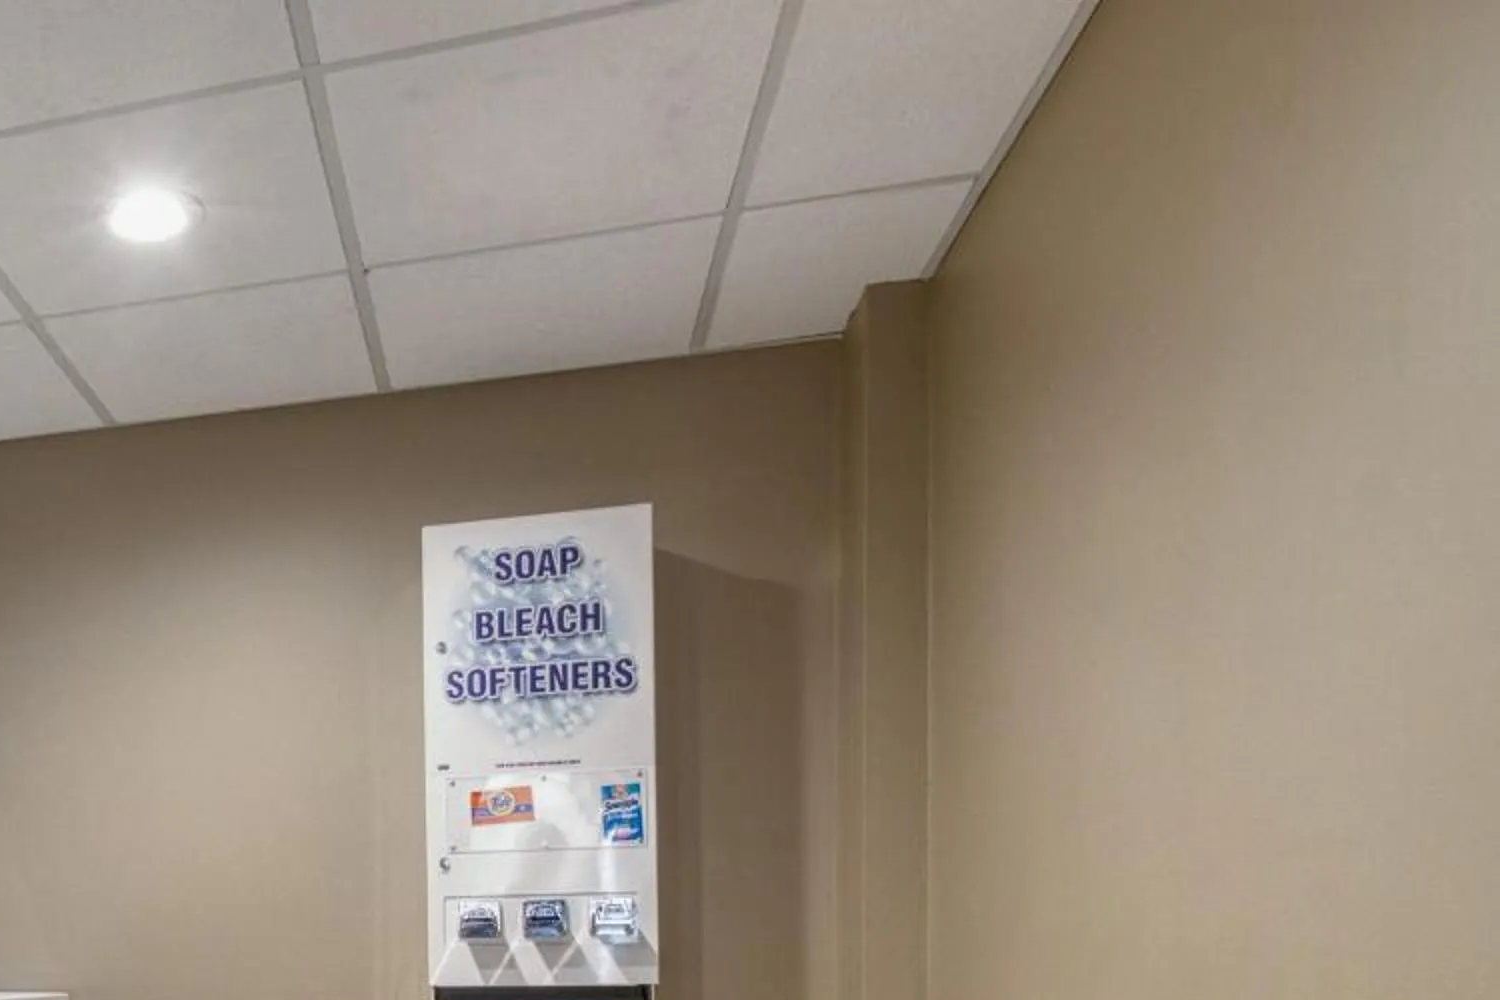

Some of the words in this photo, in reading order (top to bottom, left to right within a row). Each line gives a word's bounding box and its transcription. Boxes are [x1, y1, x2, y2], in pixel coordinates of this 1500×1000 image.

[494, 546, 582, 582] SOAP
[474, 601, 603, 641] BLEACH
[446, 657, 636, 700] SOFTENERS
